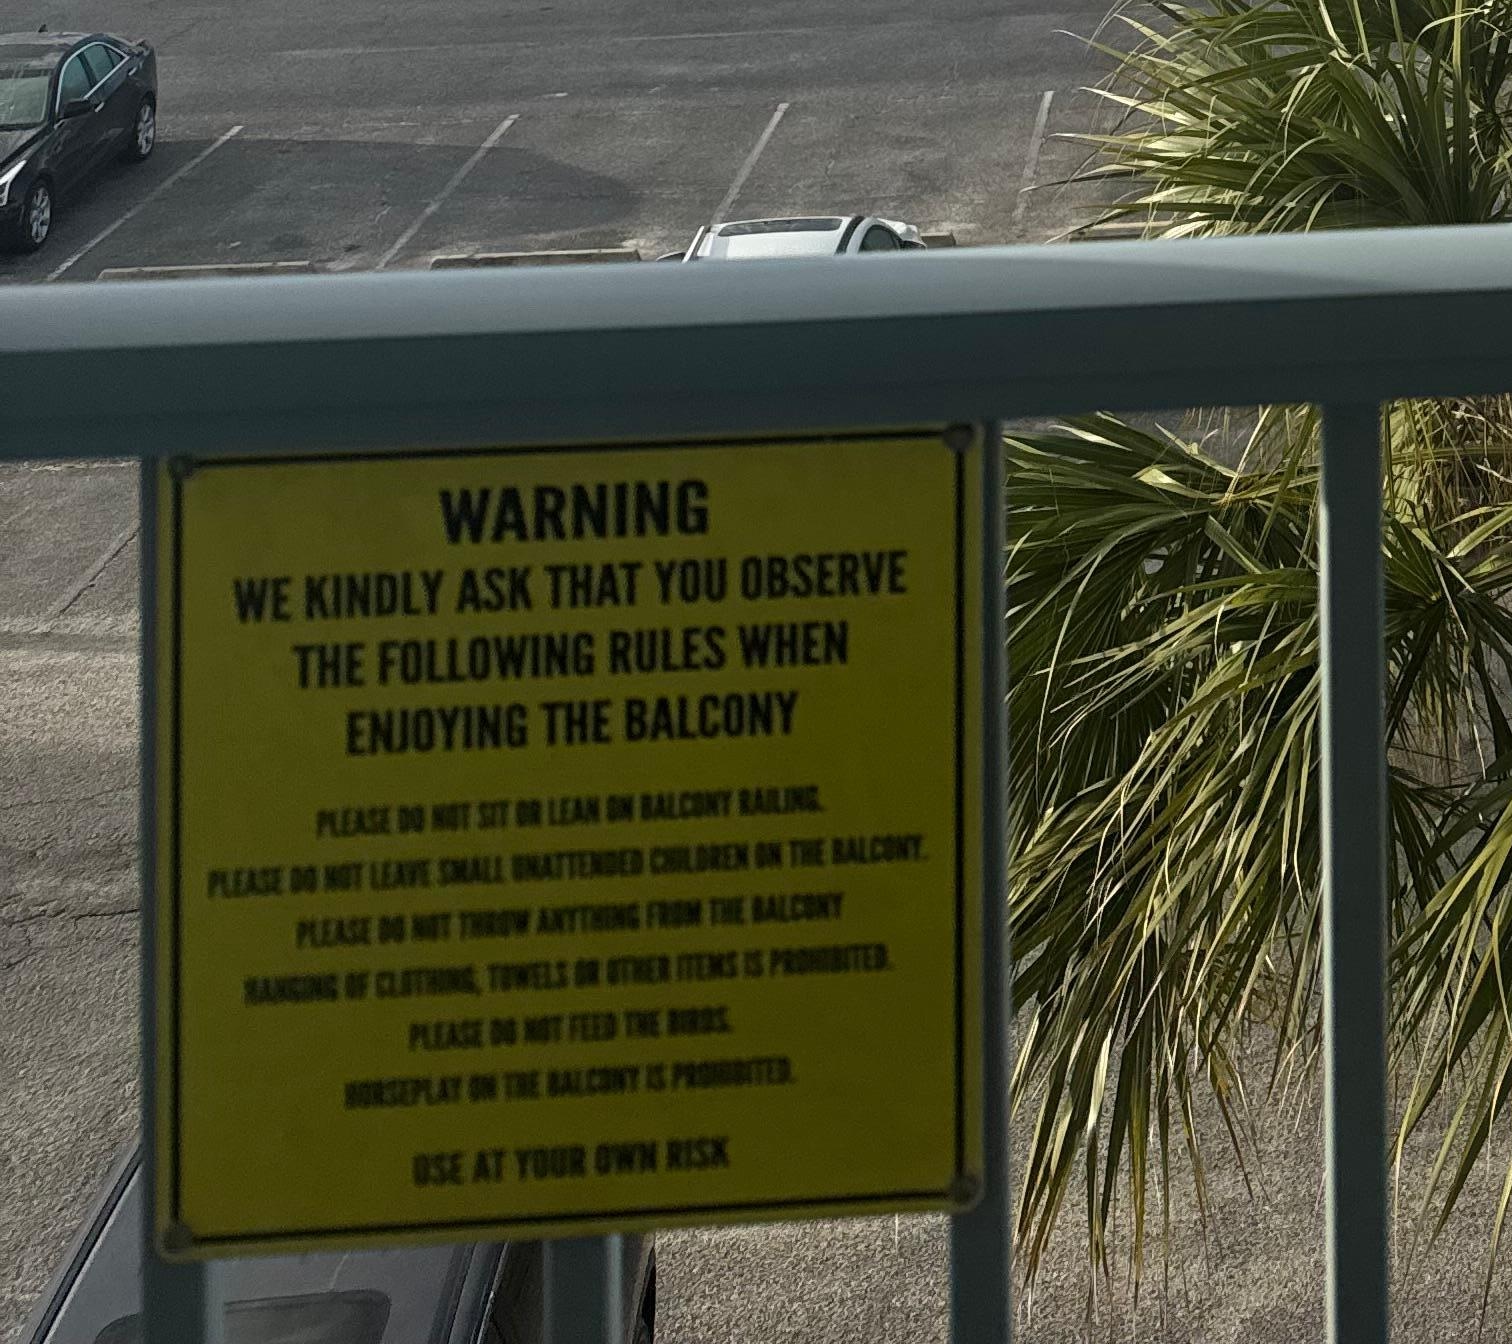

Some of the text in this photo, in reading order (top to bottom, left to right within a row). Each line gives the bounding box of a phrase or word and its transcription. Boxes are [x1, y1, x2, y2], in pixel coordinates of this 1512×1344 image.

[438, 479, 710, 545] WARNING
[232, 548, 909, 623] WE KINDLY ASK THAT YOU OBSERVE
[292, 619, 849, 690] THE FOLLOWING RULES WHEN
[345, 689, 800, 757] ENJOYING THE BALCONY
[316, 806, 391, 838] PLEASE
[398, 805, 426, 833] DO
[432, 802, 471, 831] NOT
[478, 800, 509, 829] SIT
[516, 799, 542, 827] OR
[548, 797, 600, 826] LEAN
[606, 795, 634, 823] ON
[640, 790, 732, 821] BALCONY
[208, 866, 284, 898] PLEASE
[289, 863, 318, 895] DO
[323, 862, 365, 893] NOT
[370, 859, 430, 890] LEAVE
[438, 856, 504, 886] SMALL
[512, 849, 644, 882] UNATTENDED
[756, 842, 782, 868] ON
[789, 838, 825, 867] THE
[297, 918, 369, 948] PLEASE
[380, 916, 405, 943] DO
[413, 913, 451, 940] NOT
[538, 904, 639, 933] ANYTHING
[648, 900, 701, 927] FROM
[710, 897, 744, 924] THE
[753, 892, 844, 922] BALCONY
[344, 970, 369, 1002] OF
[488, 959, 568, 991] TOWELS
[575, 960, 599, 987] OR
[608, 955, 670, 984] OTHER
[678, 951, 738, 980] ITEMS
[744, 950, 764, 977] IS
[410, 1020, 482, 1050] PLEASE
[491, 1018, 516, 1045] DO
[525, 1016, 562, 1043] NOT
[570, 1013, 616, 1041] FEED
[625, 1011, 659, 1037] THE
[469, 1074, 497, 1101] ON
[503, 1071, 539, 1098] THE
[548, 1066, 640, 1096] BALCONY
[647, 1063, 665, 1090] IS
[413, 1137, 729, 1186] USE AT YOUR OWN RISK
